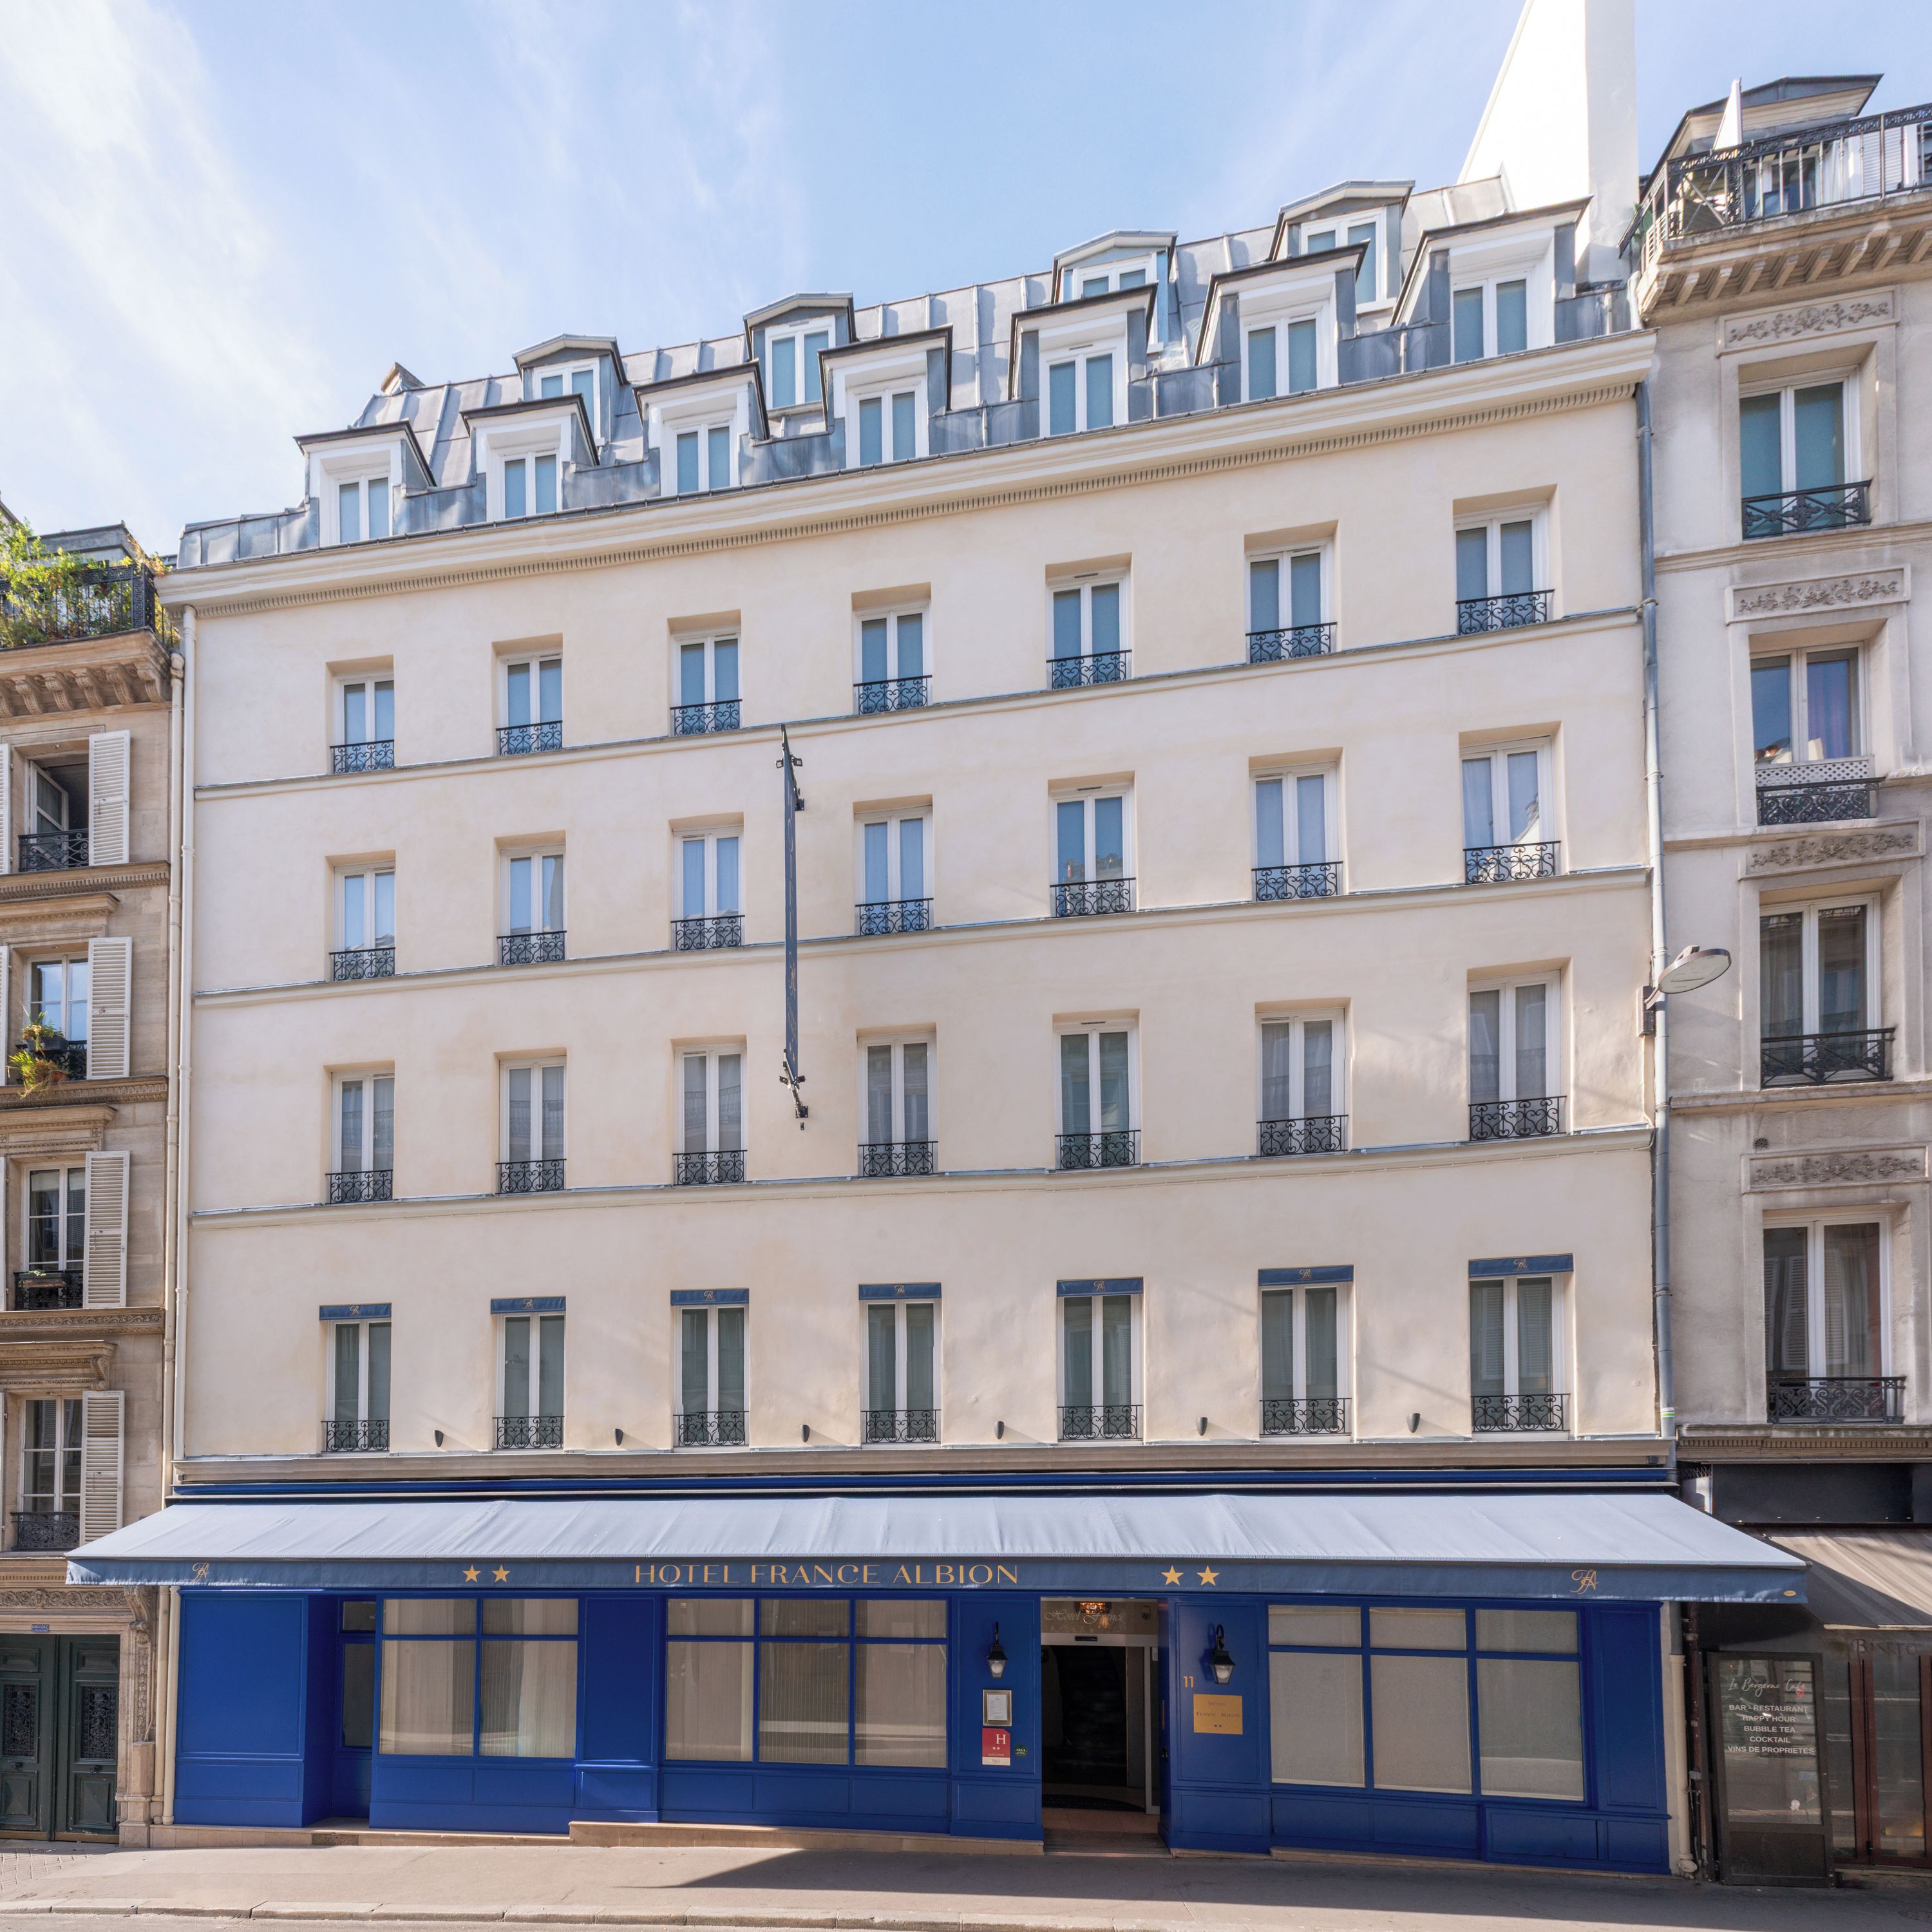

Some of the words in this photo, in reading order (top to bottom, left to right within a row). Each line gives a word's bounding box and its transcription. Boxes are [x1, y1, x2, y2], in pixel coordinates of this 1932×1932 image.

[635, 1564, 739, 1584] HOTEL
[750, 1564, 881, 1584] FRANCE
[893, 1564, 1018, 1584] ALBION
[1044, 1609, 1081, 1621] Hotel
[1183, 1676, 1194, 1688] 11
[1728, 1678, 1739, 1690] Le
[1741, 1678, 1780, 1697] Bergerac
[996, 1734, 1006, 1744] H
